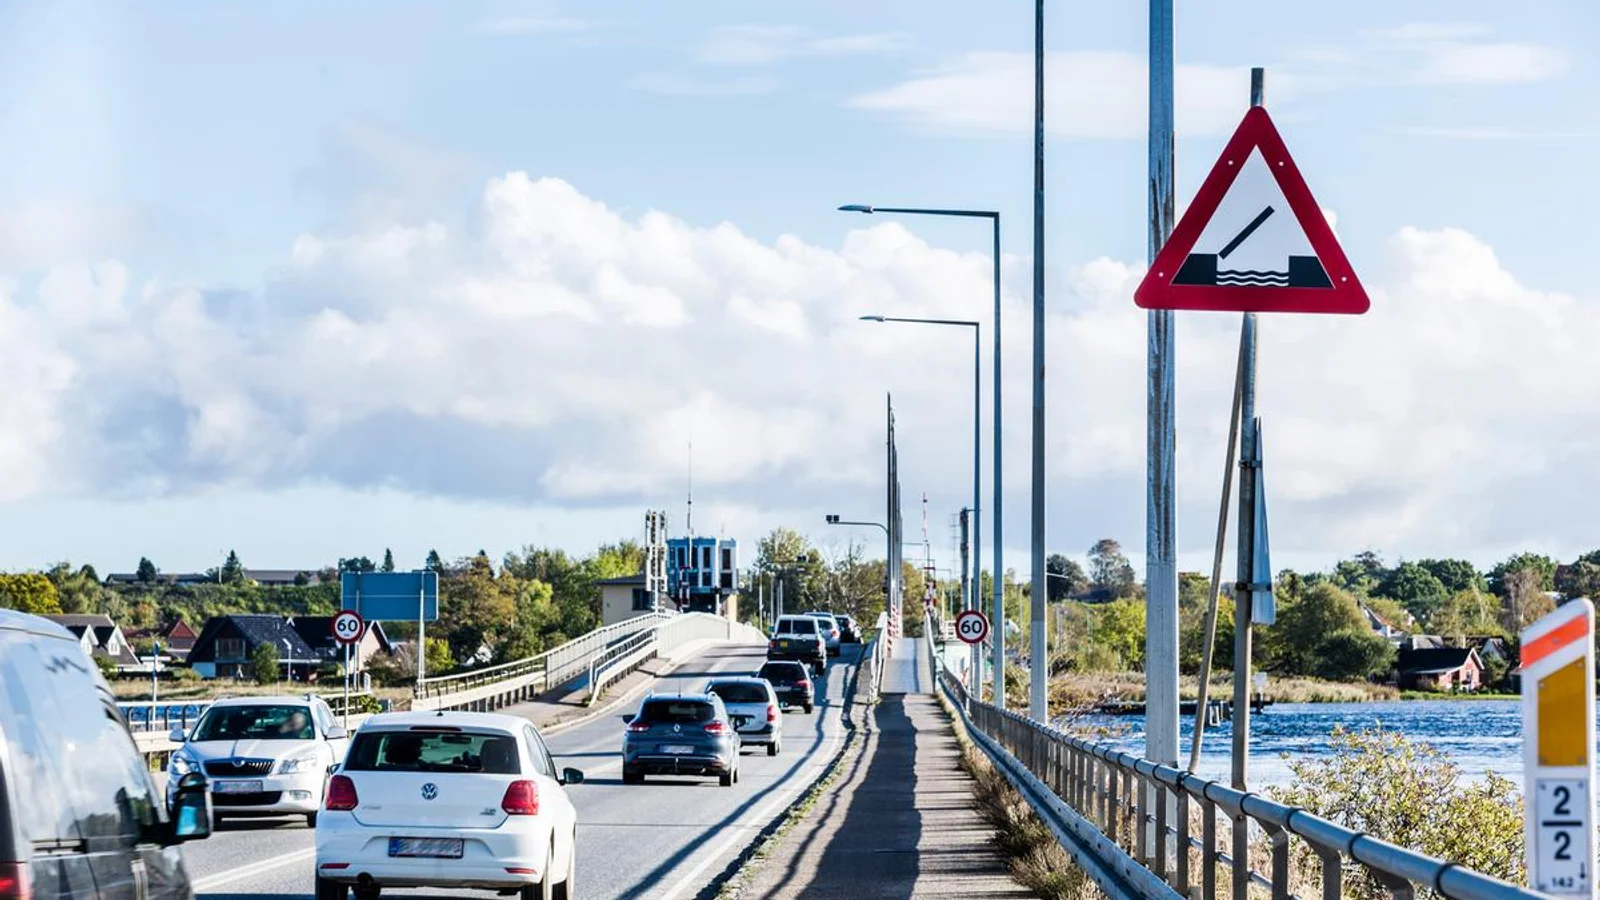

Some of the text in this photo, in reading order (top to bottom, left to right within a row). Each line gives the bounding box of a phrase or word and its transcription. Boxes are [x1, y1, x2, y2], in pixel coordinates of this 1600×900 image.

[337, 619, 358, 632] 60
[961, 620, 982, 634] 60
[1553, 785, 1571, 814] 2
[1553, 831, 1572, 860] 2
